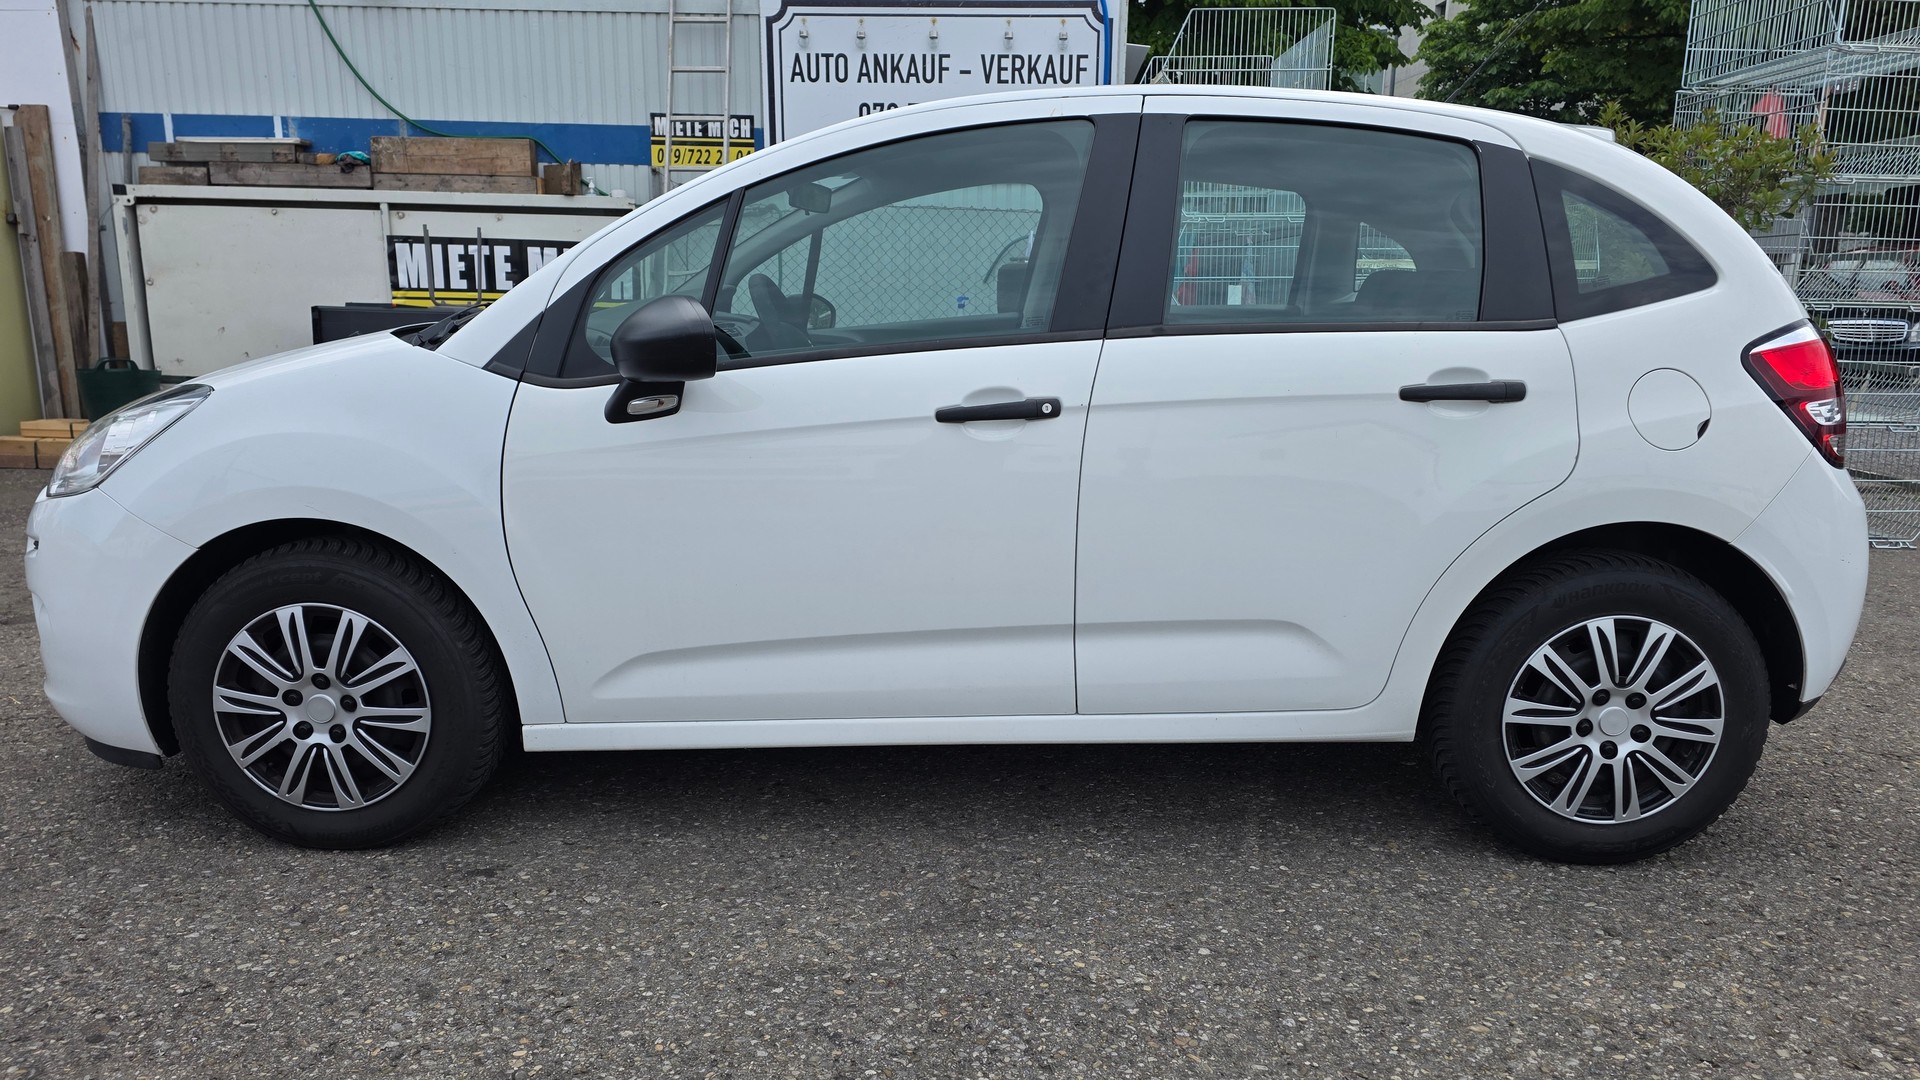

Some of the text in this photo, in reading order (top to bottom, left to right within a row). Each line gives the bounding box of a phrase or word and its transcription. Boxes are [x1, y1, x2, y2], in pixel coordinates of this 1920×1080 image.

[790, 53, 848, 83] AUTO
[857, 54, 950, 84] ANKAUF
[981, 54, 1089, 85] VERKAUF
[657, 148, 711, 165] 09/722
[394, 242, 514, 290] MIETE
